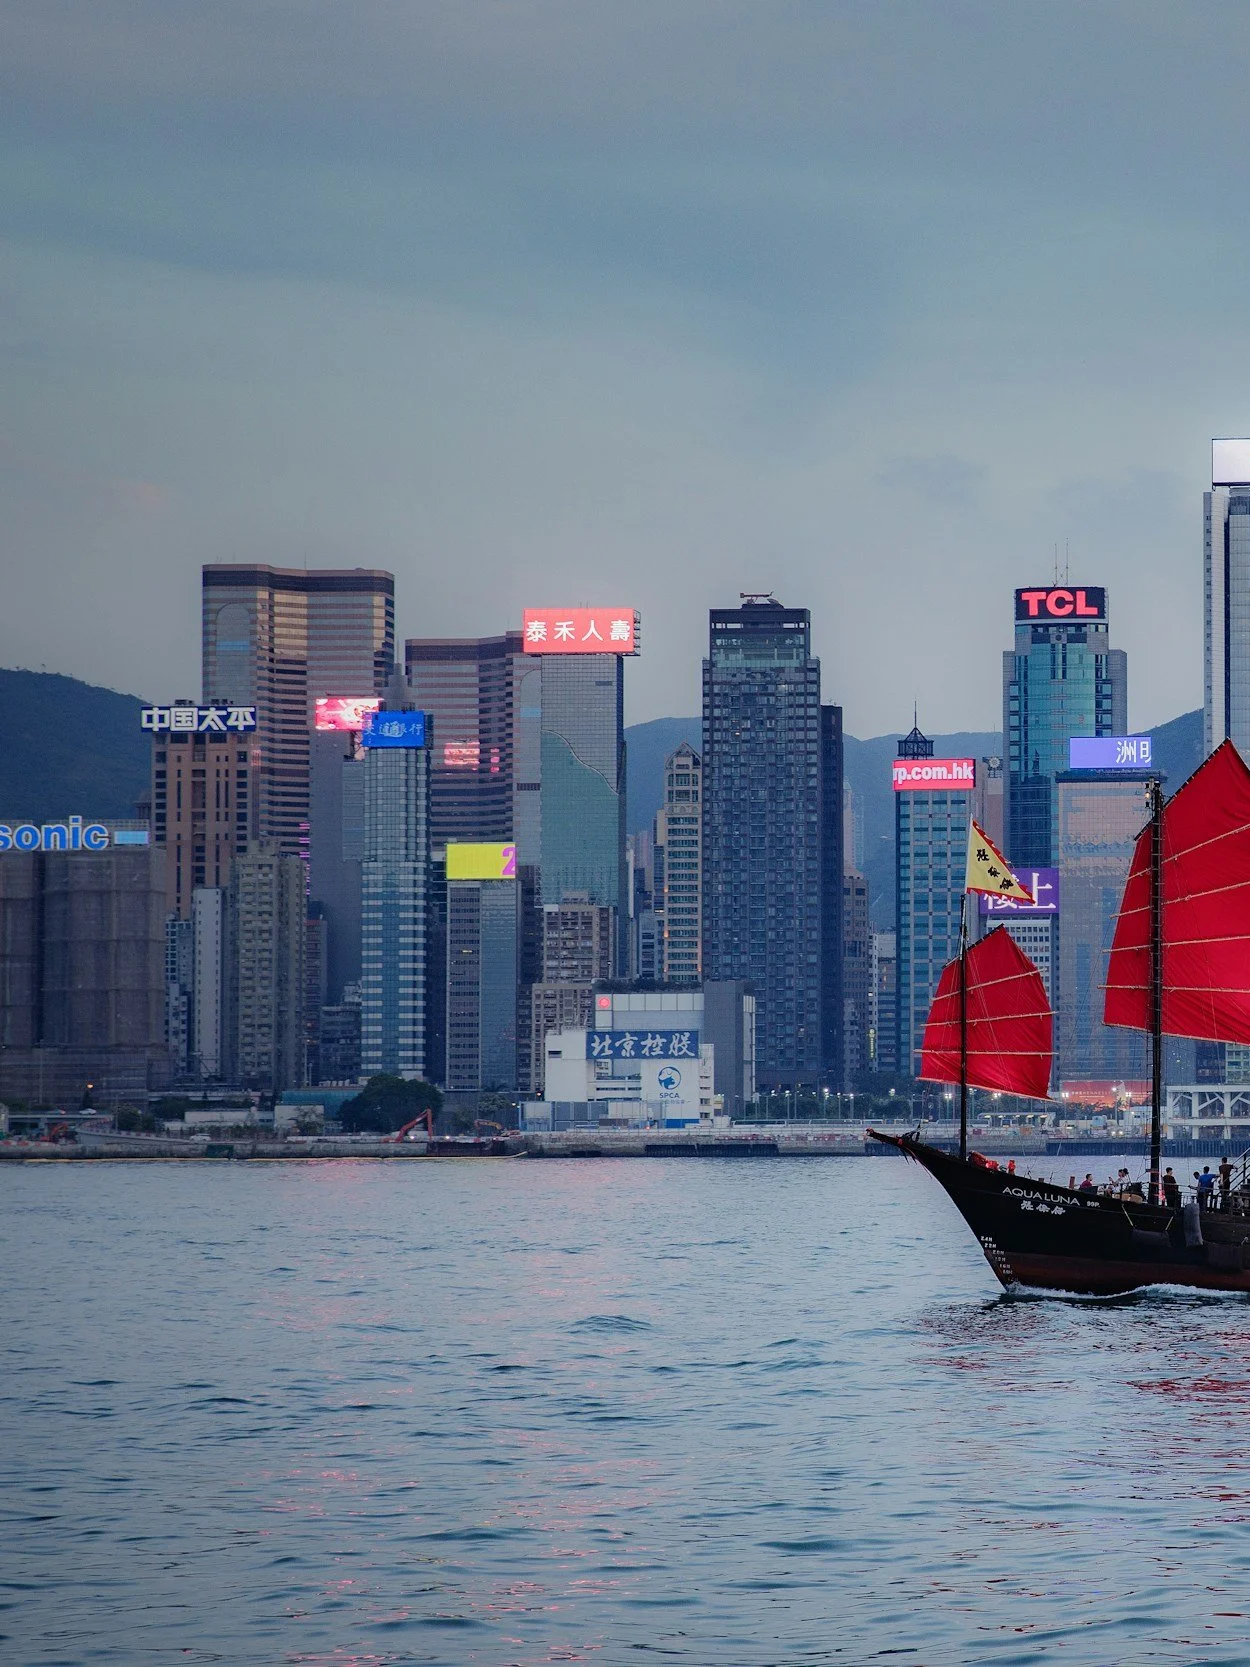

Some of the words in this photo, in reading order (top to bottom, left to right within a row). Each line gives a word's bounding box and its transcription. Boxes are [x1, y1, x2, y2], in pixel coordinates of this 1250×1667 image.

[1021, 589, 1098, 616] TCL
[526, 619, 631, 642] 泰禾人壽
[141, 707, 256, 732] 中国太平
[590, 1031, 696, 1057] 北京控股
[1002, 1186, 1043, 1200] AQUA
[1044, 1192, 1081, 1206] LUNA
